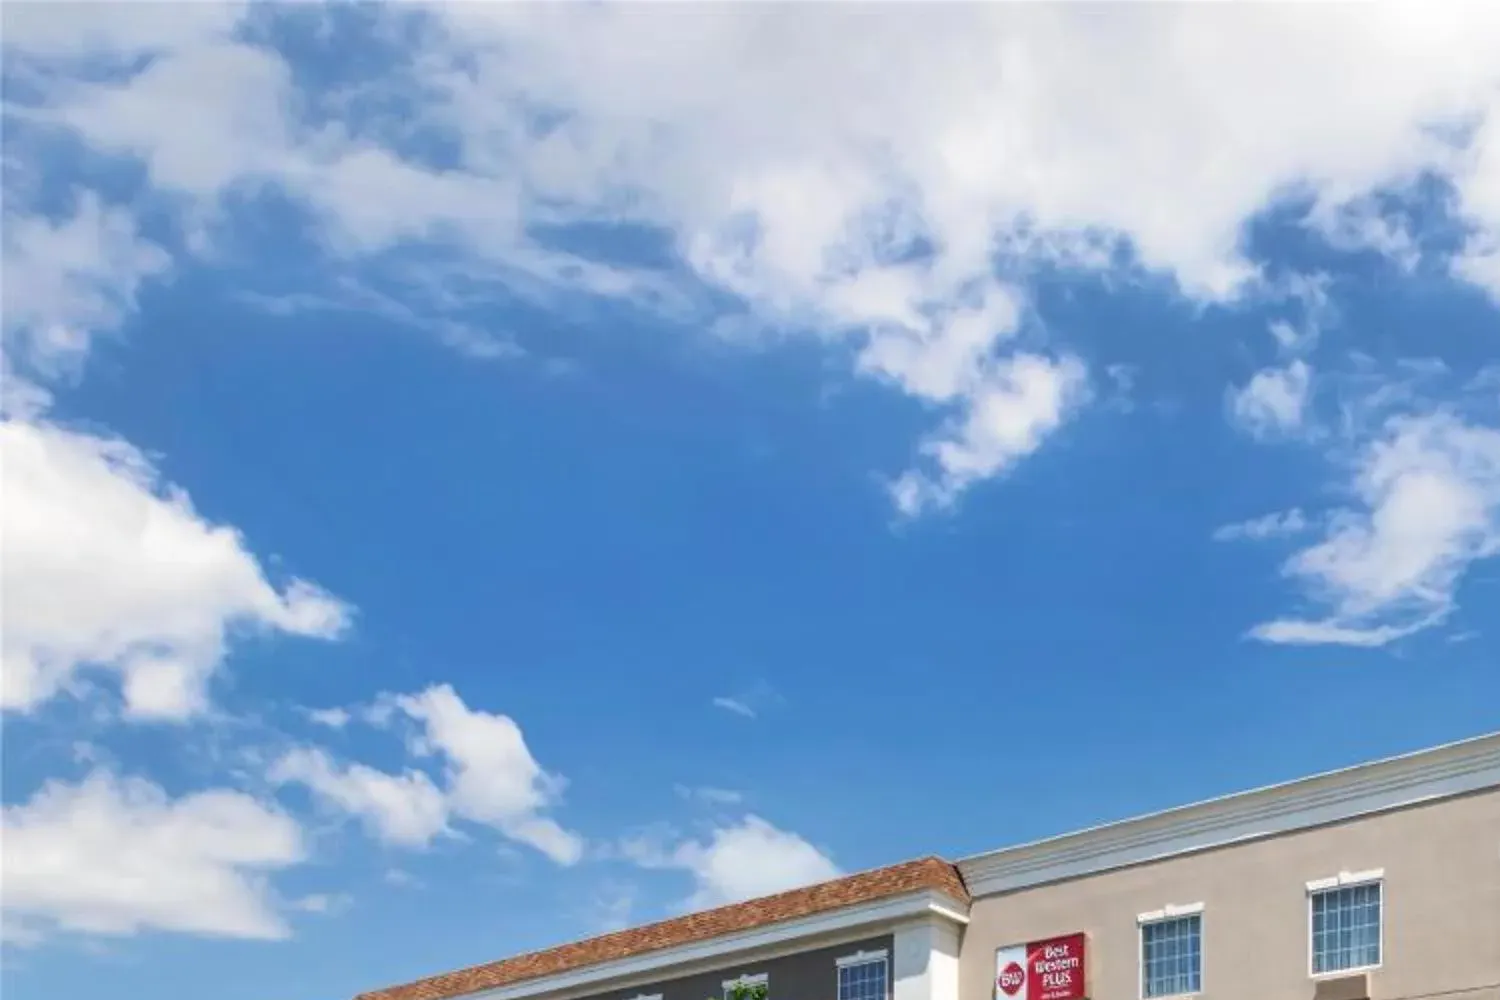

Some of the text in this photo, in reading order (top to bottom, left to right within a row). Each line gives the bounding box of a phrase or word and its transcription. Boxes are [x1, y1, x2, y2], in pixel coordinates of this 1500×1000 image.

[1045, 945, 1069, 959] Best
[1034, 957, 1079, 973] Western
[1042, 970, 1072, 986] PLUS
